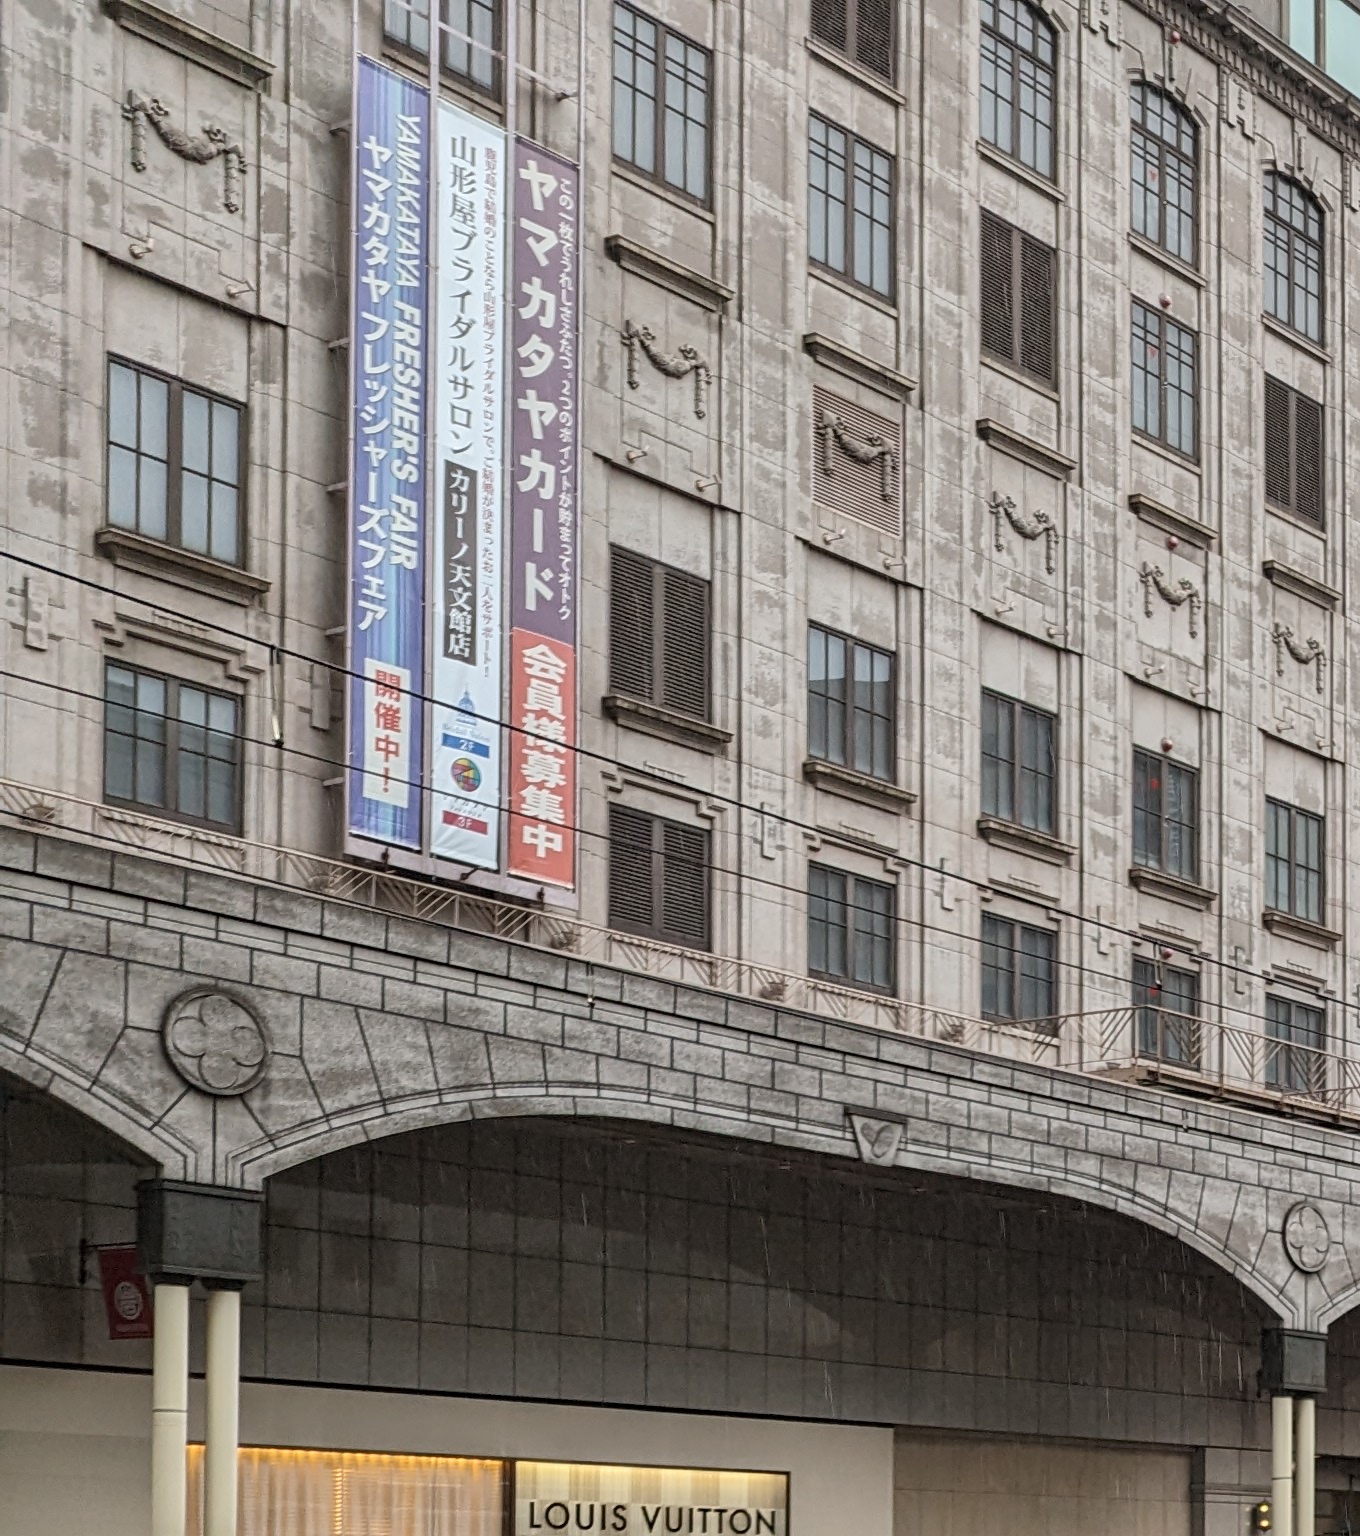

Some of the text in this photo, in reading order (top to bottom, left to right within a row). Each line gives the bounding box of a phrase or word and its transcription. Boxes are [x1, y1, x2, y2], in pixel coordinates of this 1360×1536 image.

[390, 113, 422, 571] YAMAKATAYA FRESHER'S FAIR
[447, 135, 477, 455] 山形屋ブライダルサロン
[516, 159, 559, 612] ヤマカタヤカード
[447, 469, 474, 658] カリーノ天文館店
[373, 669, 402, 794] 開催中!
[521, 644, 567, 858] 会員様募集中
[528, 1501, 776, 1536] LOUIS VUITTON
